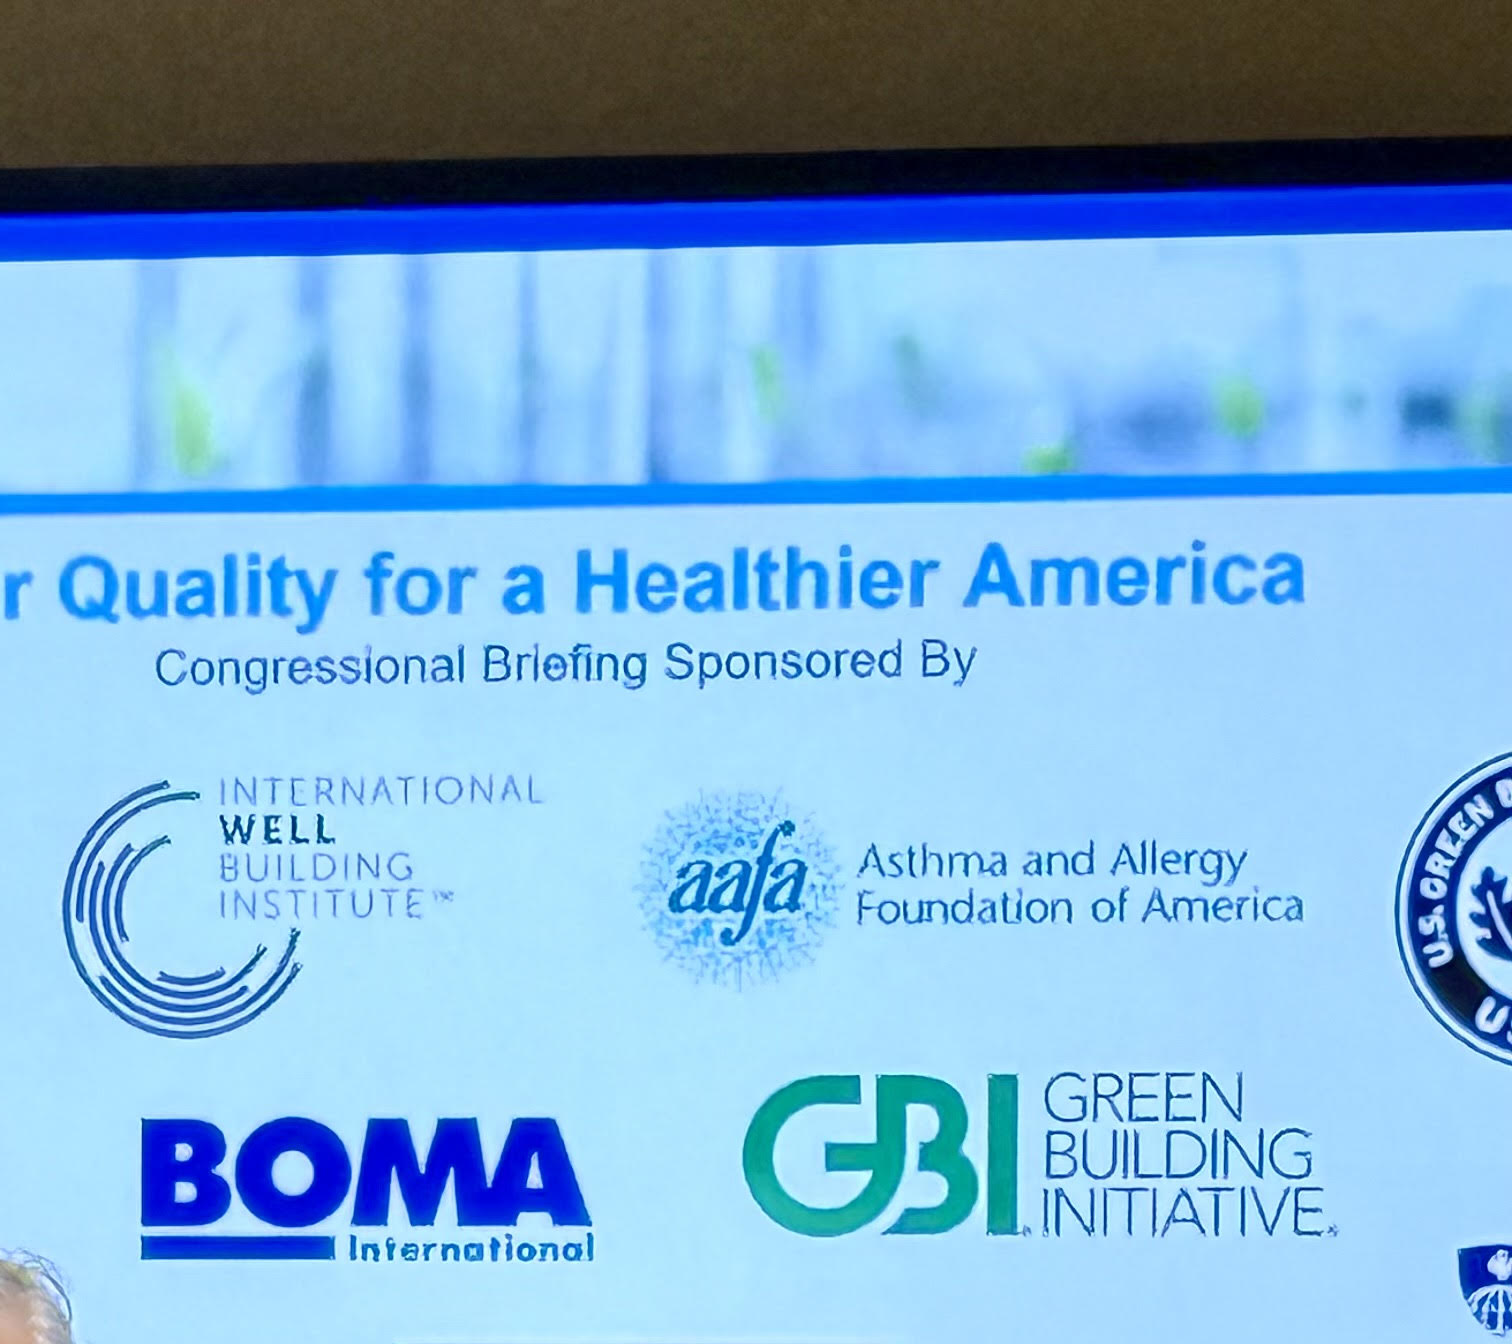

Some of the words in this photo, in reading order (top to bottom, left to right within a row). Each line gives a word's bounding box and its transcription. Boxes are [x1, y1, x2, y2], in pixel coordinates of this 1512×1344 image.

[58, 552, 336, 634] Quality
[364, 551, 478, 616] for
[502, 562, 545, 615] a
[576, 544, 941, 615] Healthier
[962, 539, 1306, 608] America
[155, 644, 465, 695] Congressional
[482, 642, 648, 690] Briefing
[664, 639, 903, 690] Sponsored
[921, 638, 978, 688] By
[219, 773, 545, 807] INTERNATIONAL
[219, 813, 336, 846] WELL
[219, 852, 414, 883] BUILDING
[667, 819, 809, 947] aafa
[856, 841, 1009, 879] Asthma
[1021, 840, 1096, 878] and
[1108, 839, 1249, 888] Allergy
[856, 886, 1074, 927] Foundation
[1090, 885, 1132, 924] of
[1140, 885, 1306, 924] America
[1043, 1071, 1244, 1124] GREEN
[141, 1115, 593, 1229] BOMA
[741, 1072, 1020, 1239] GBI
[1044, 1128, 1313, 1181] BUILDING
[1042, 1186, 1326, 1239] INITIATIVE
[349, 1231, 595, 1262] International
